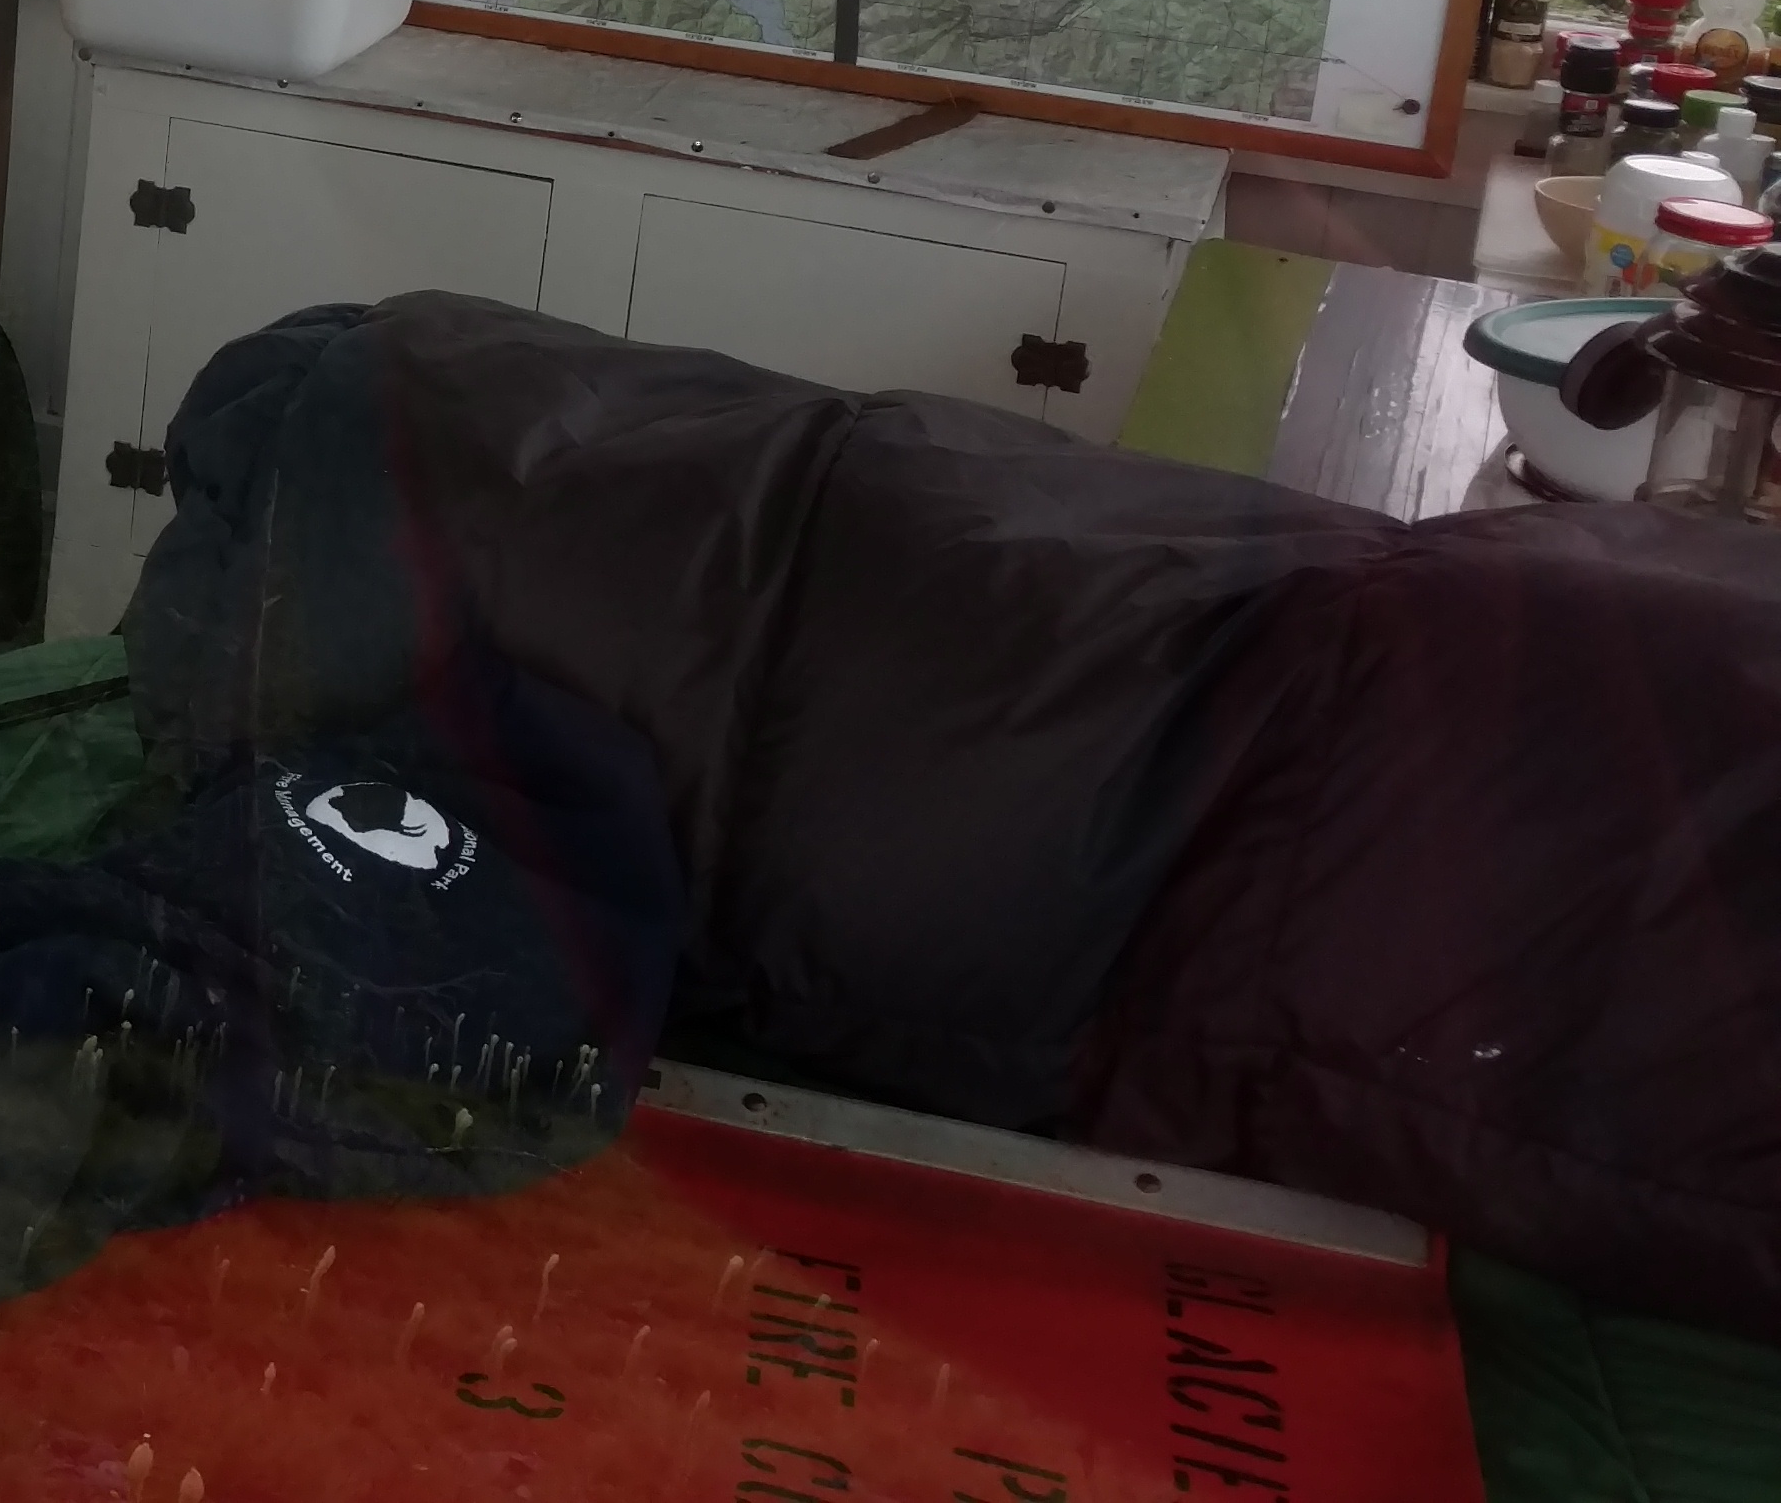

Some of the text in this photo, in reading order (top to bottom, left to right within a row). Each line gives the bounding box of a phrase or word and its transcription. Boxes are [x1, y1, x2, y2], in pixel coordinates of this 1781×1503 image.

[430, 862, 471, 891] Park
[746, 1247, 863, 1407] FIRE
[1164, 1260, 1291, 1503] GLACIE
